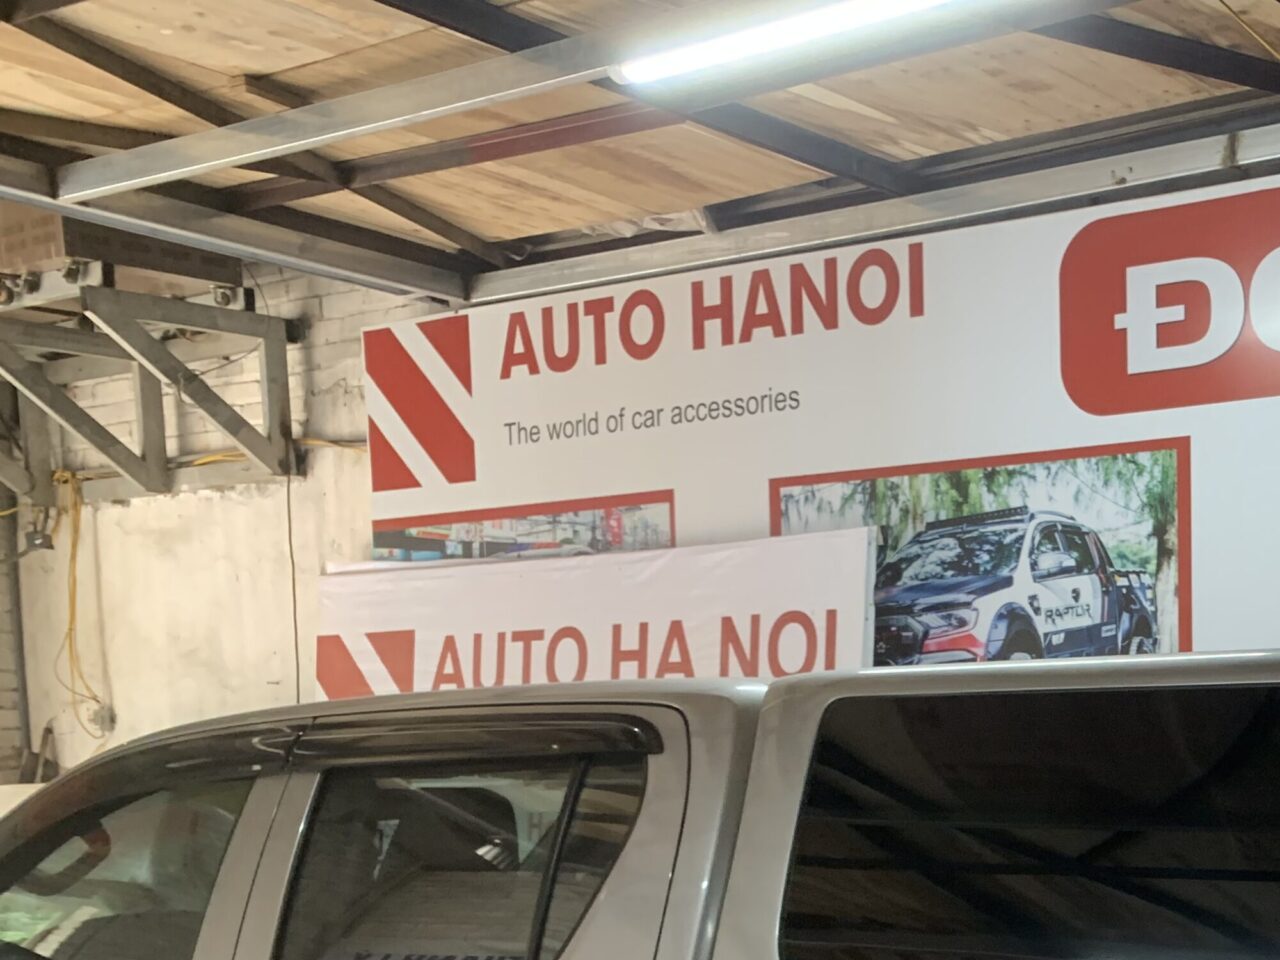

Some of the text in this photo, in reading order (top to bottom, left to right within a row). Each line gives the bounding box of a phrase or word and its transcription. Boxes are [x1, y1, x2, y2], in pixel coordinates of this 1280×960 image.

[500, 242, 924, 379] AUTO HANOI
[504, 388, 800, 447] The world of car accessories
[432, 608, 837, 690] AUTO HA NOI
